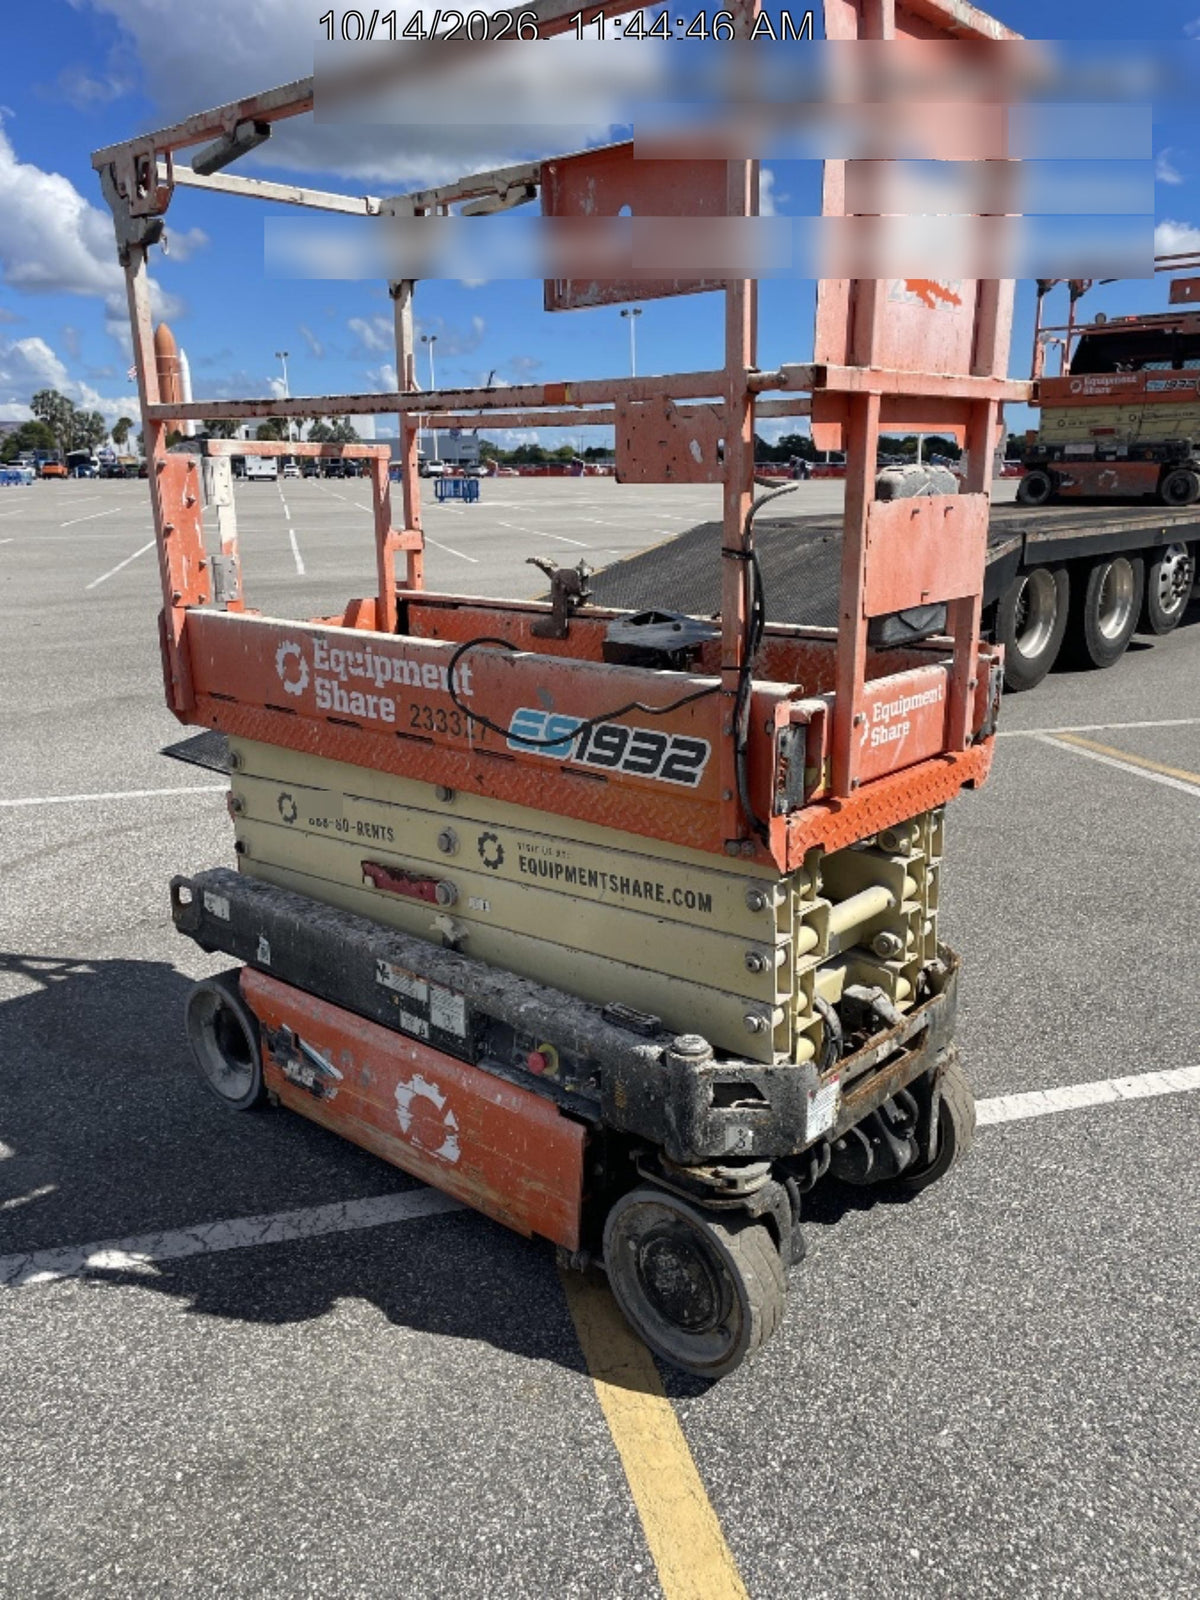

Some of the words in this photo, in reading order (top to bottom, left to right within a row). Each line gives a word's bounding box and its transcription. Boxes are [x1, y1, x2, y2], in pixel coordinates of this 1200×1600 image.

[312, 638, 474, 696] Equipment
[314, 675, 396, 722] Share
[873, 684, 942, 723] Equipment
[507, 707, 711, 788] ES1932
[871, 721, 910, 747] Share
[518, 855, 712, 912] EQUIPMENTSHARE.COM
